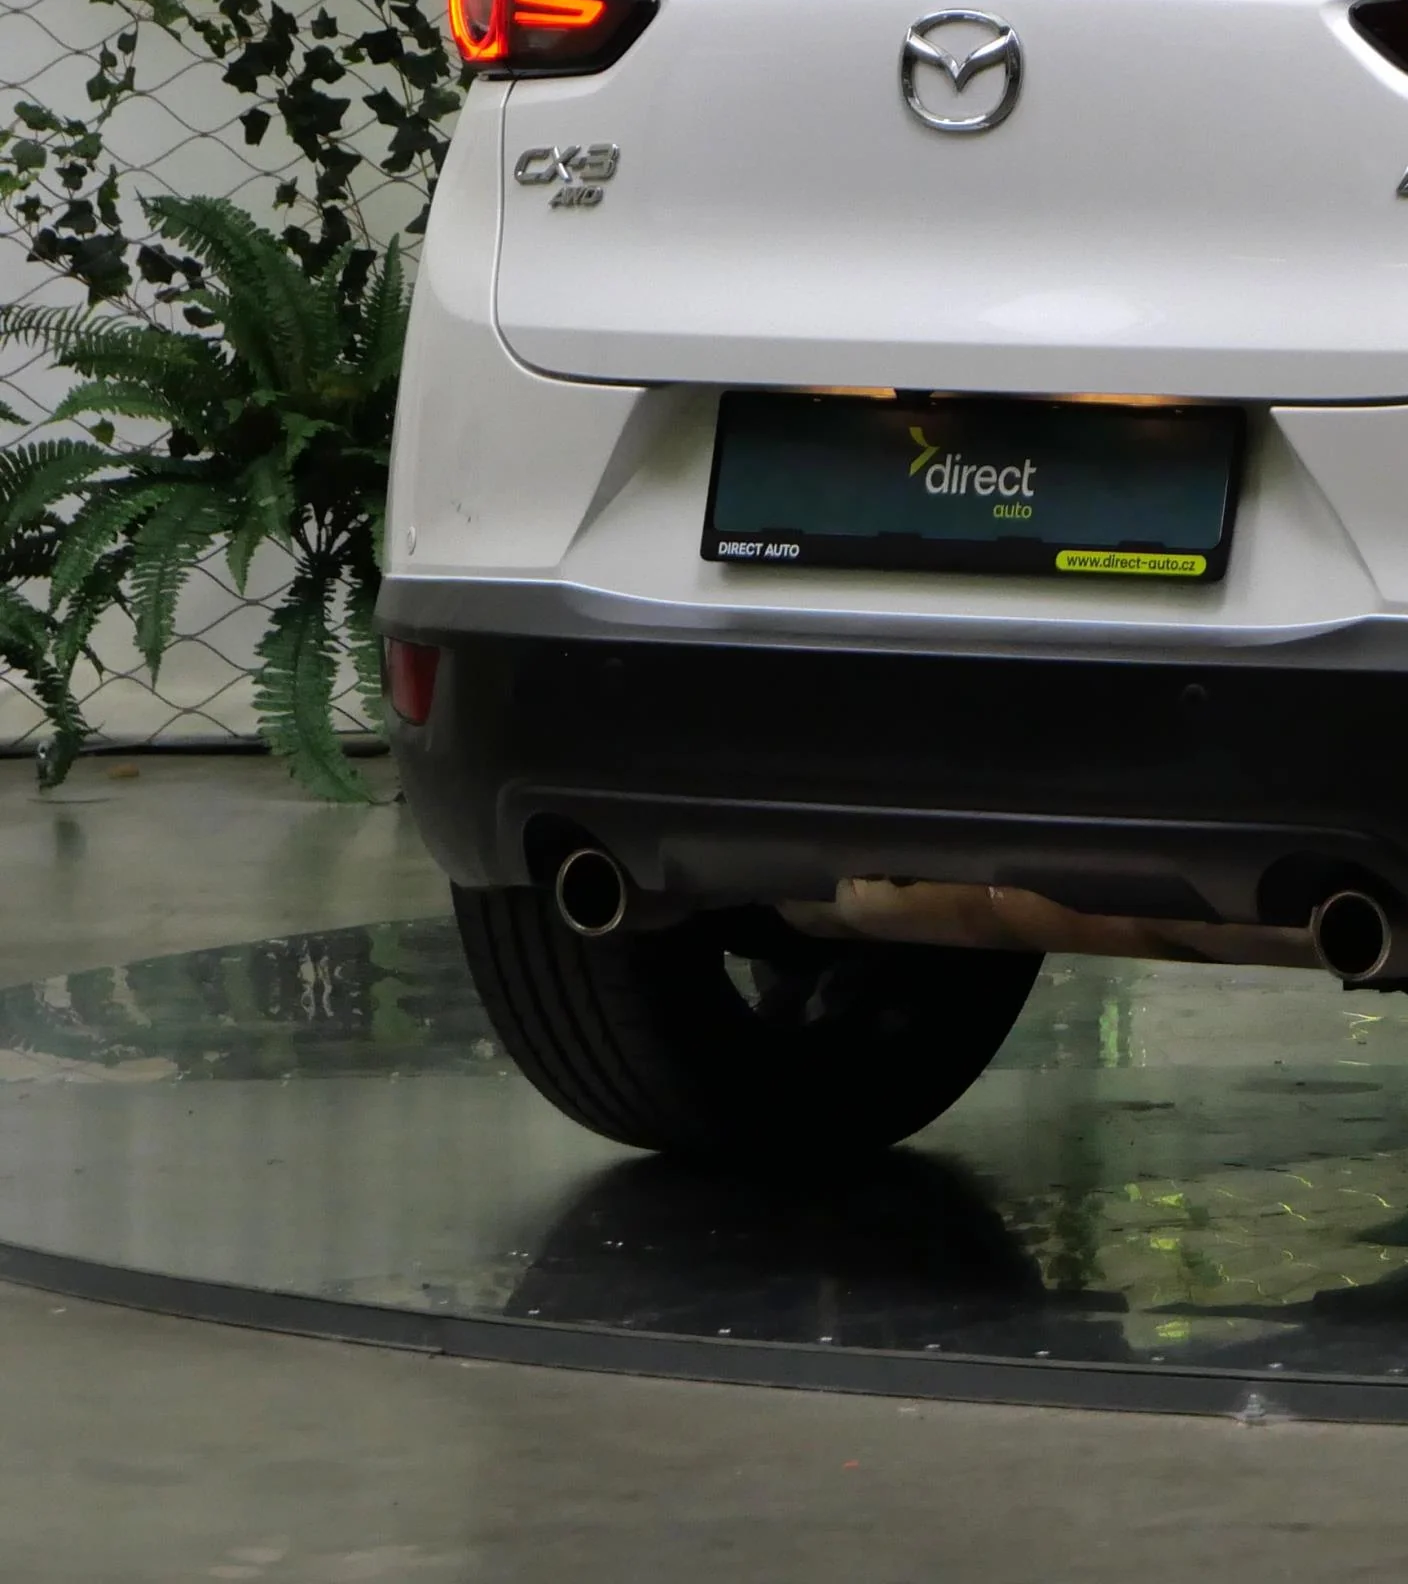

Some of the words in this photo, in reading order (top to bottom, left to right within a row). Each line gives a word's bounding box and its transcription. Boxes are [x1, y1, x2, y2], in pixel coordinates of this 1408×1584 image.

[514, 144, 620, 185] CX-3
[549, 186, 604, 209] AWD
[925, 453, 1037, 497] direct
[993, 501, 1033, 519] auto
[718, 541, 763, 556] DIRECT
[764, 543, 800, 558] AUTO
[1066, 554, 1196, 572] www.direct-auto.cz
